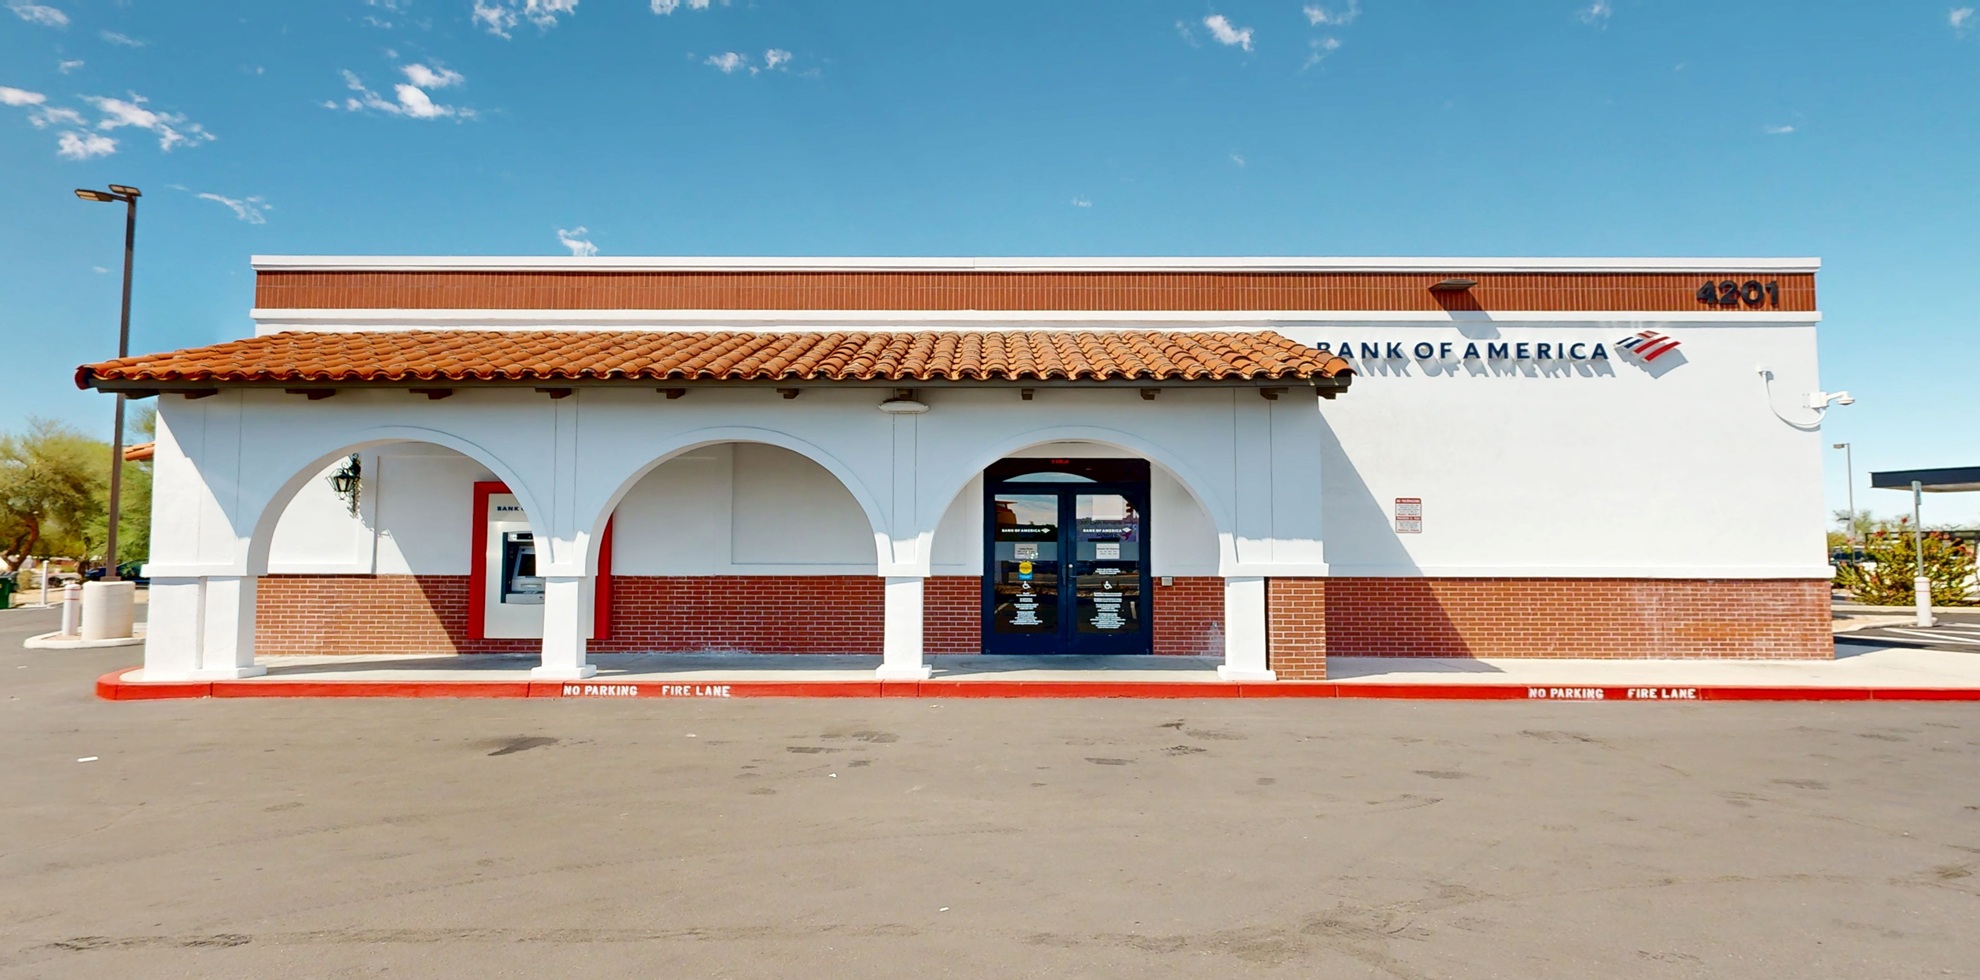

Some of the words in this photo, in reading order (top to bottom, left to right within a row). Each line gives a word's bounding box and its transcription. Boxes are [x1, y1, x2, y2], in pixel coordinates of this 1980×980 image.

[1696, 280, 1779, 305] 4201
[1414, 341, 1453, 360] OF
[1463, 341, 1609, 360] AMERICA
[563, 685, 580, 696] NO
[584, 685, 638, 696] PARKING
[662, 685, 690, 696] FIRE
[695, 685, 731, 697] LANE
[1528, 688, 1546, 699] NO
[1551, 688, 1604, 699] PARKING
[1627, 688, 1657, 699] FIRE
[1661, 688, 1696, 699] LANE
